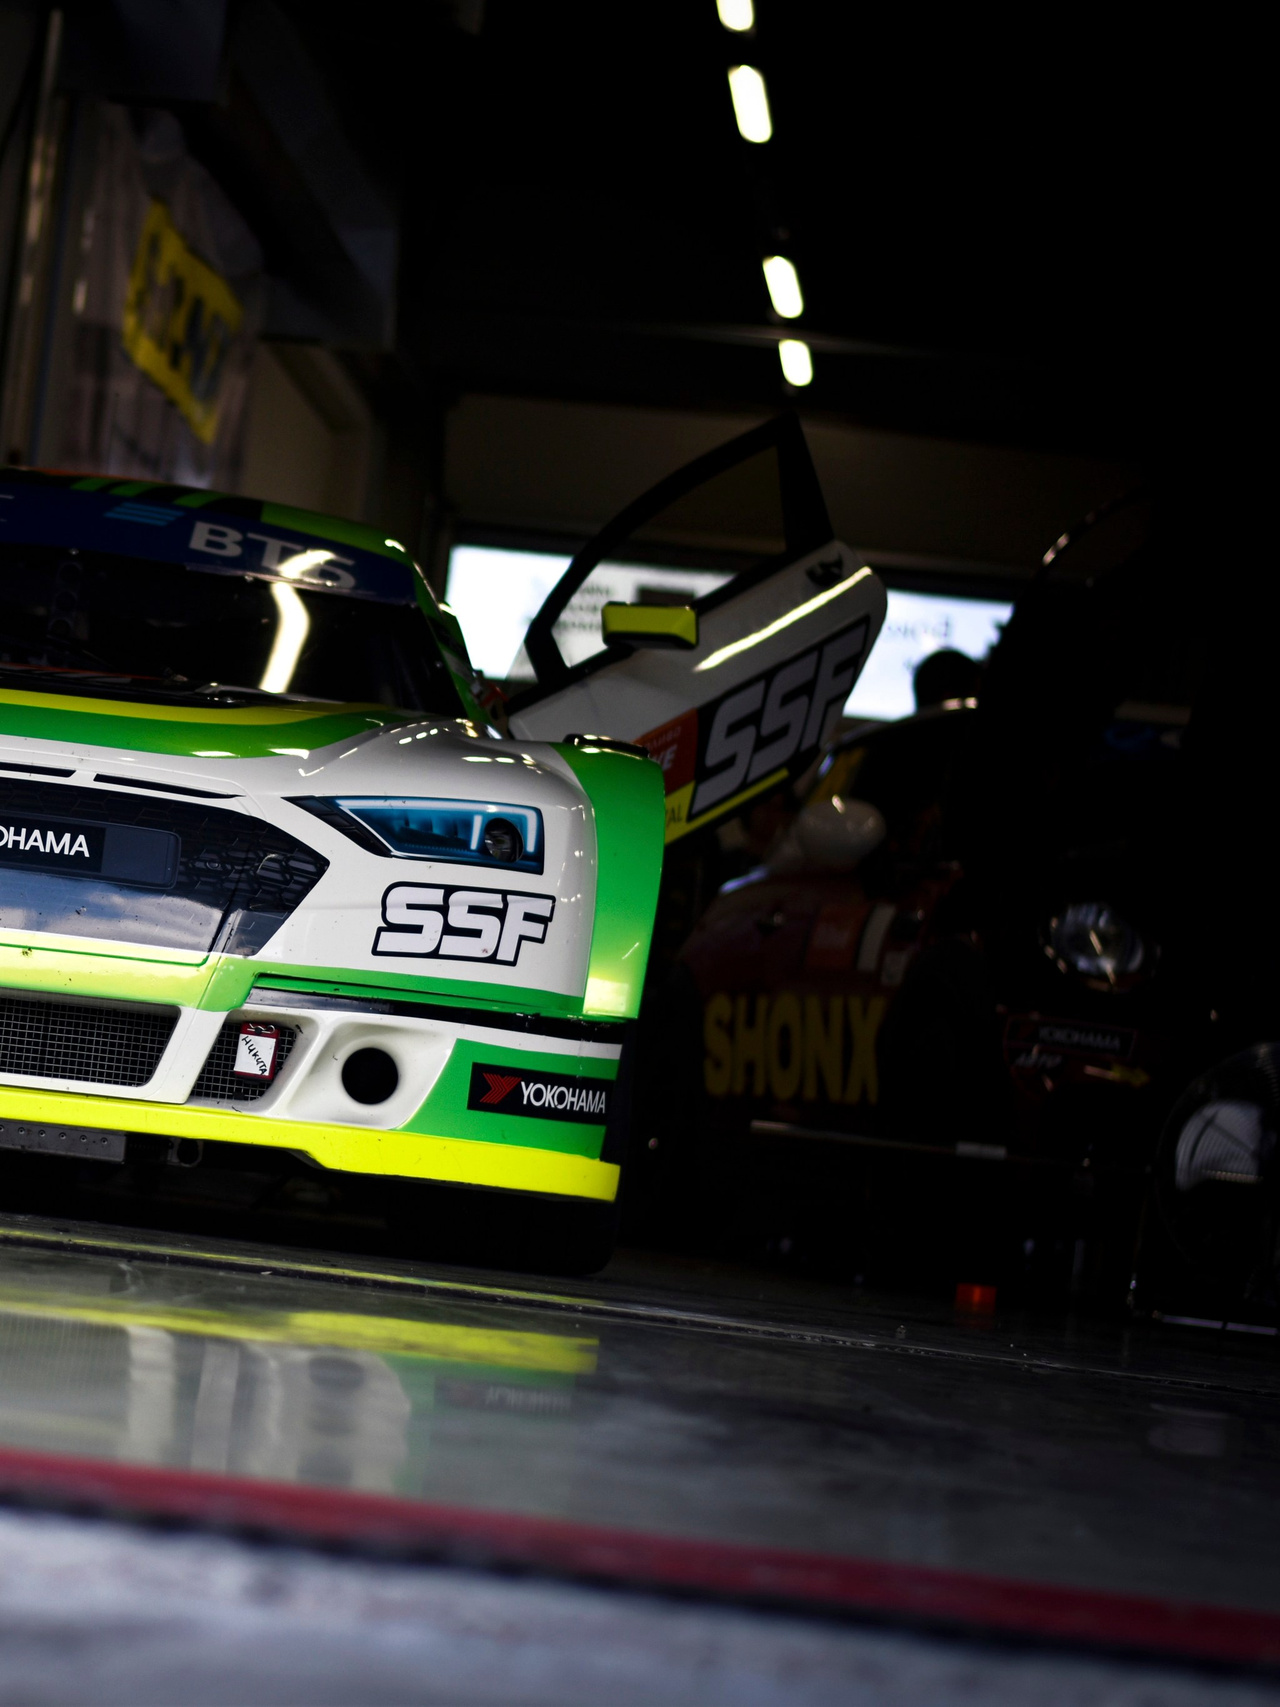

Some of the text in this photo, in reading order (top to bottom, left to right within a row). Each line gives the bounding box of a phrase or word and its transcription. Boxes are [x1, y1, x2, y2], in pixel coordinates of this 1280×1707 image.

[687, 616, 869, 820] SSF
[371, 881, 556, 967] SSF
[520, 1081, 607, 1114] YOKOHAMA
[703, 994, 888, 1106] SHONX
